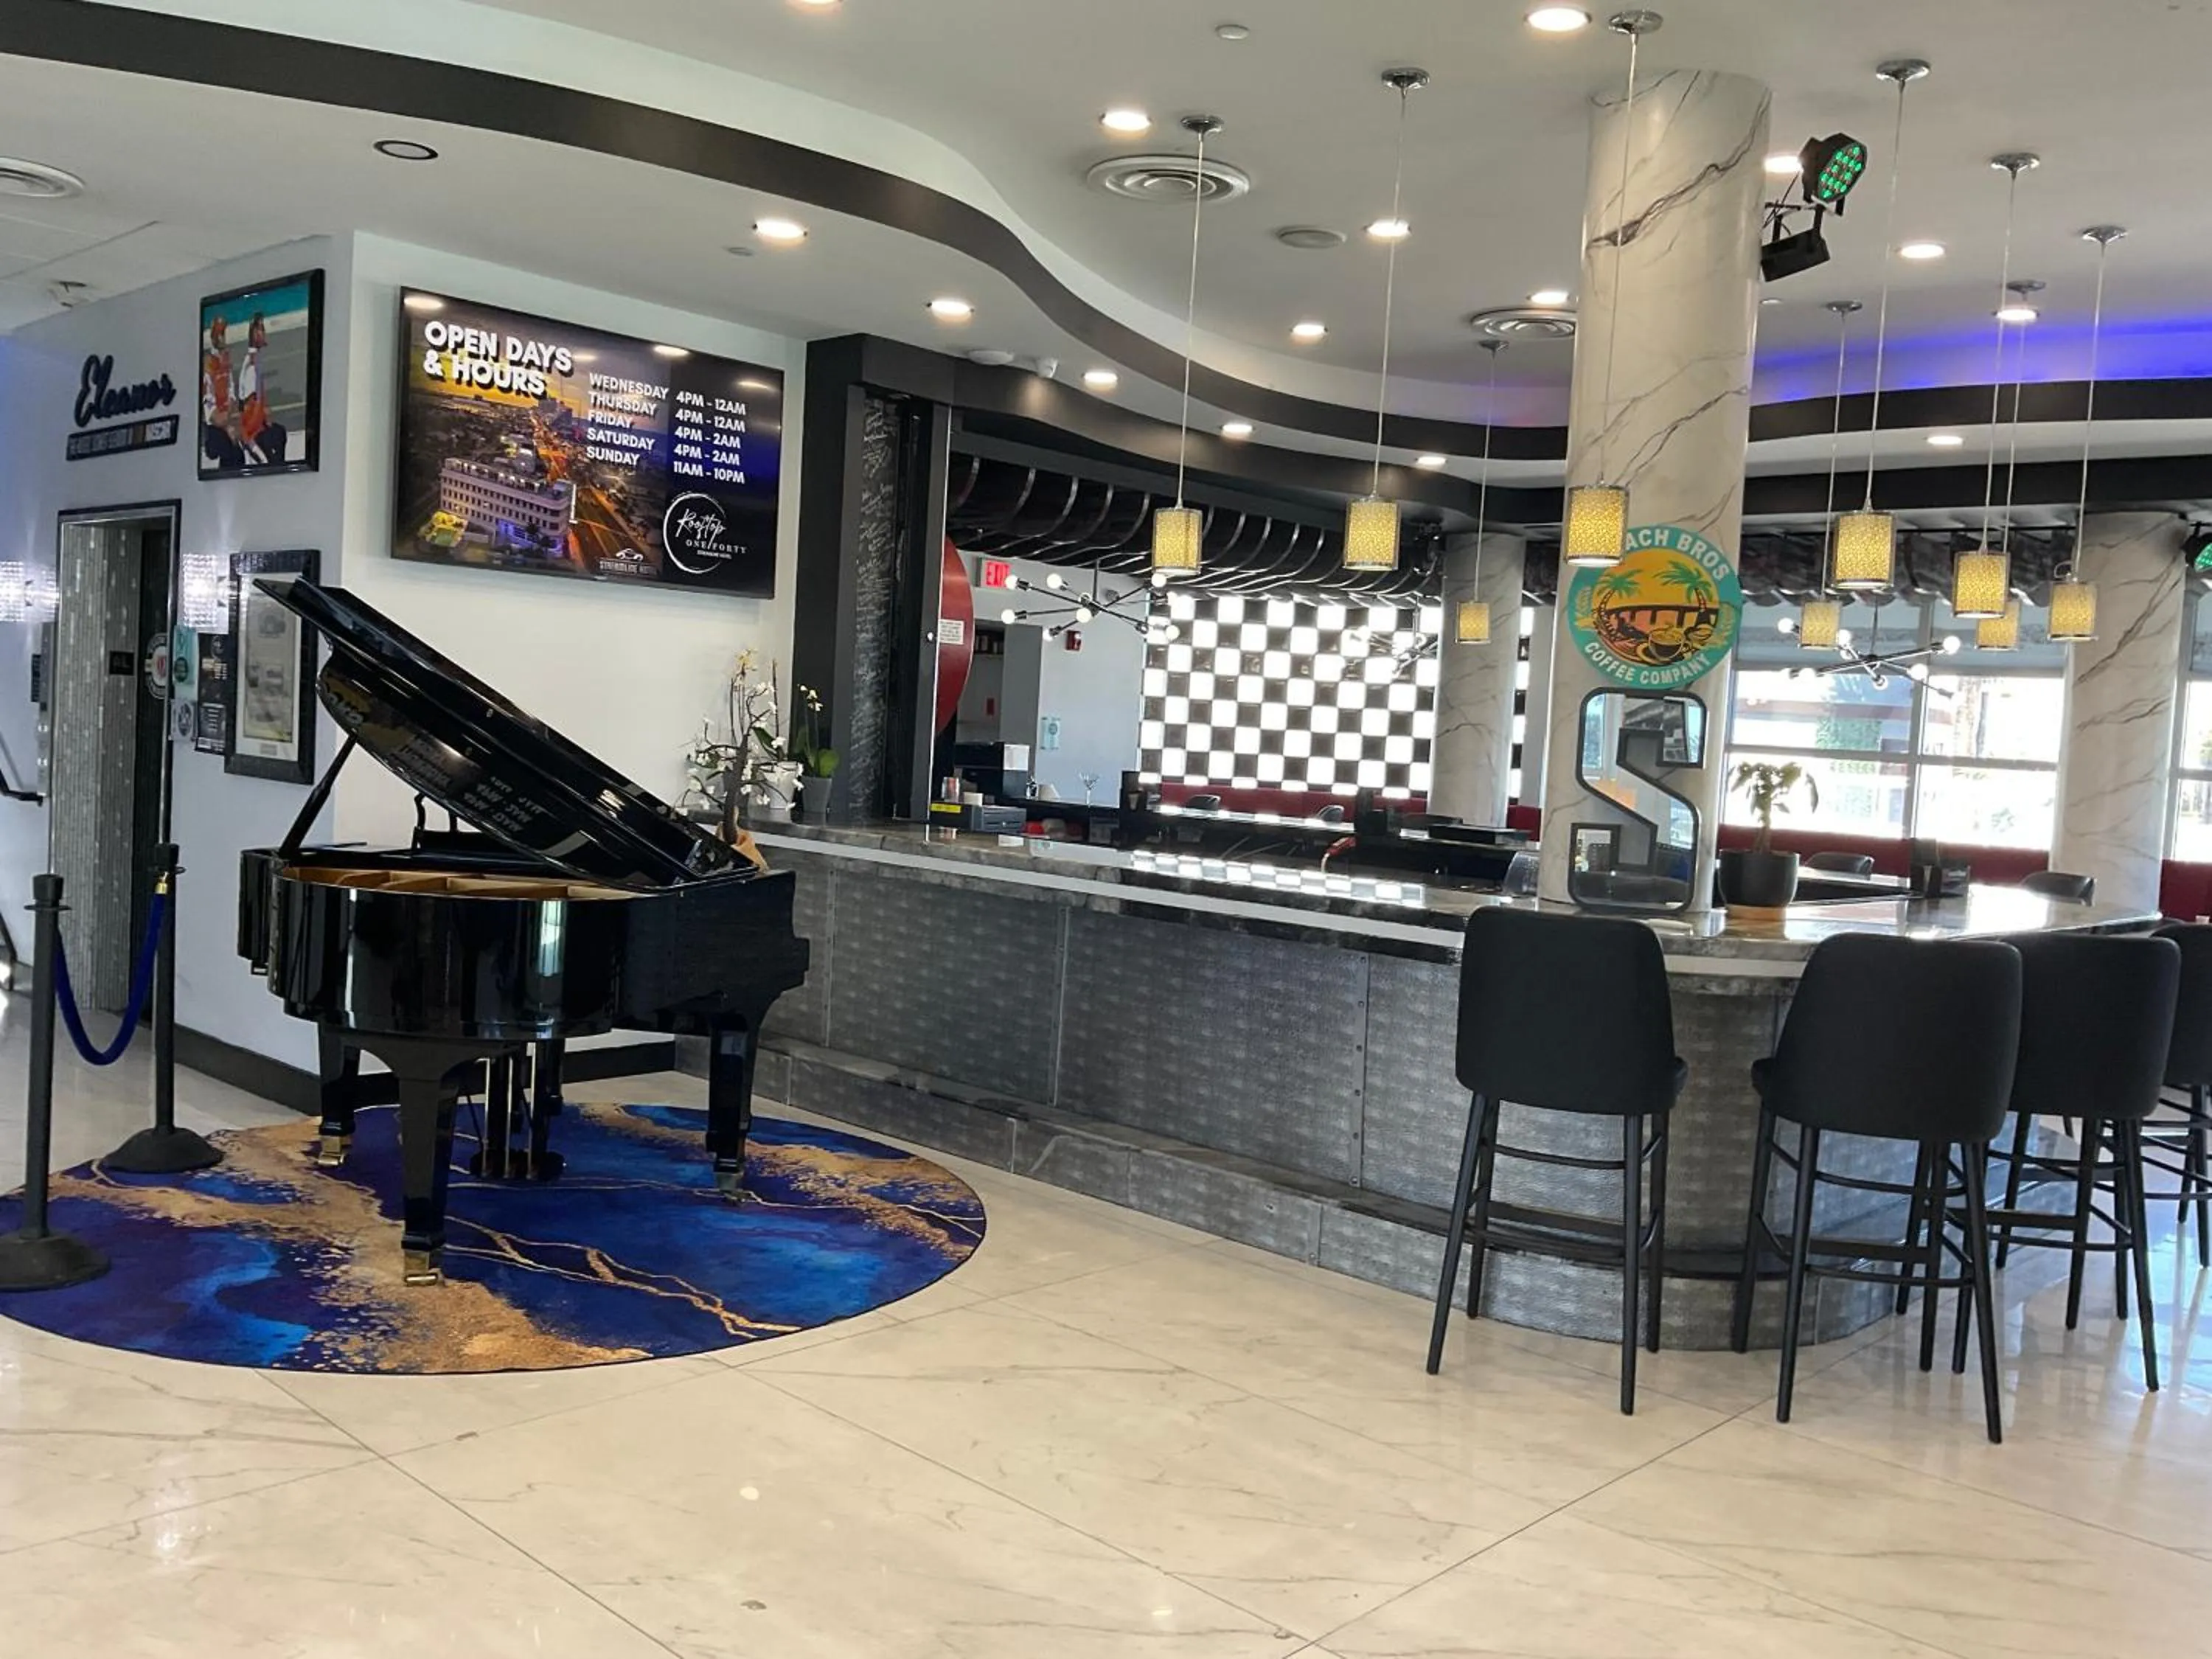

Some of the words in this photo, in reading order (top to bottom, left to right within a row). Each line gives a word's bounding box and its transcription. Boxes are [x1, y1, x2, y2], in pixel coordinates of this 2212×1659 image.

[425, 321, 498, 357] OPEN
[507, 336, 572, 372] DAYS
[423, 349, 443, 377] &
[451, 353, 545, 396] HOURS
[589, 372, 669, 400] WEDNESDAY
[676, 391, 704, 407] 4PM
[714, 398, 746, 415] 12AM
[587, 409, 633, 428] FRIDAY
[675, 425, 703, 442] 4PM
[713, 433, 741, 449] 2AM
[588, 391, 657, 415] THURSDAY
[675, 408, 703, 424] 4PM
[714, 415, 745, 433] 12AM
[586, 445, 640, 465] SUNDAY
[673, 461, 703, 477] 11AM
[714, 467, 745, 484] 10PM
[587, 427, 655, 451] SATURDAY
[673, 443, 702, 459] 4PM
[712, 450, 740, 466] 2AM
[675, 508, 726, 549] Rooftop
[686, 539, 707, 549] ONE
[712, 542, 747, 554] FORTY
[1624, 529, 1670, 551] ACH
[1677, 532, 1729, 581] BROS
[1585, 642, 1636, 681] COFFEE
[1640, 653, 1711, 685] COMPANY
